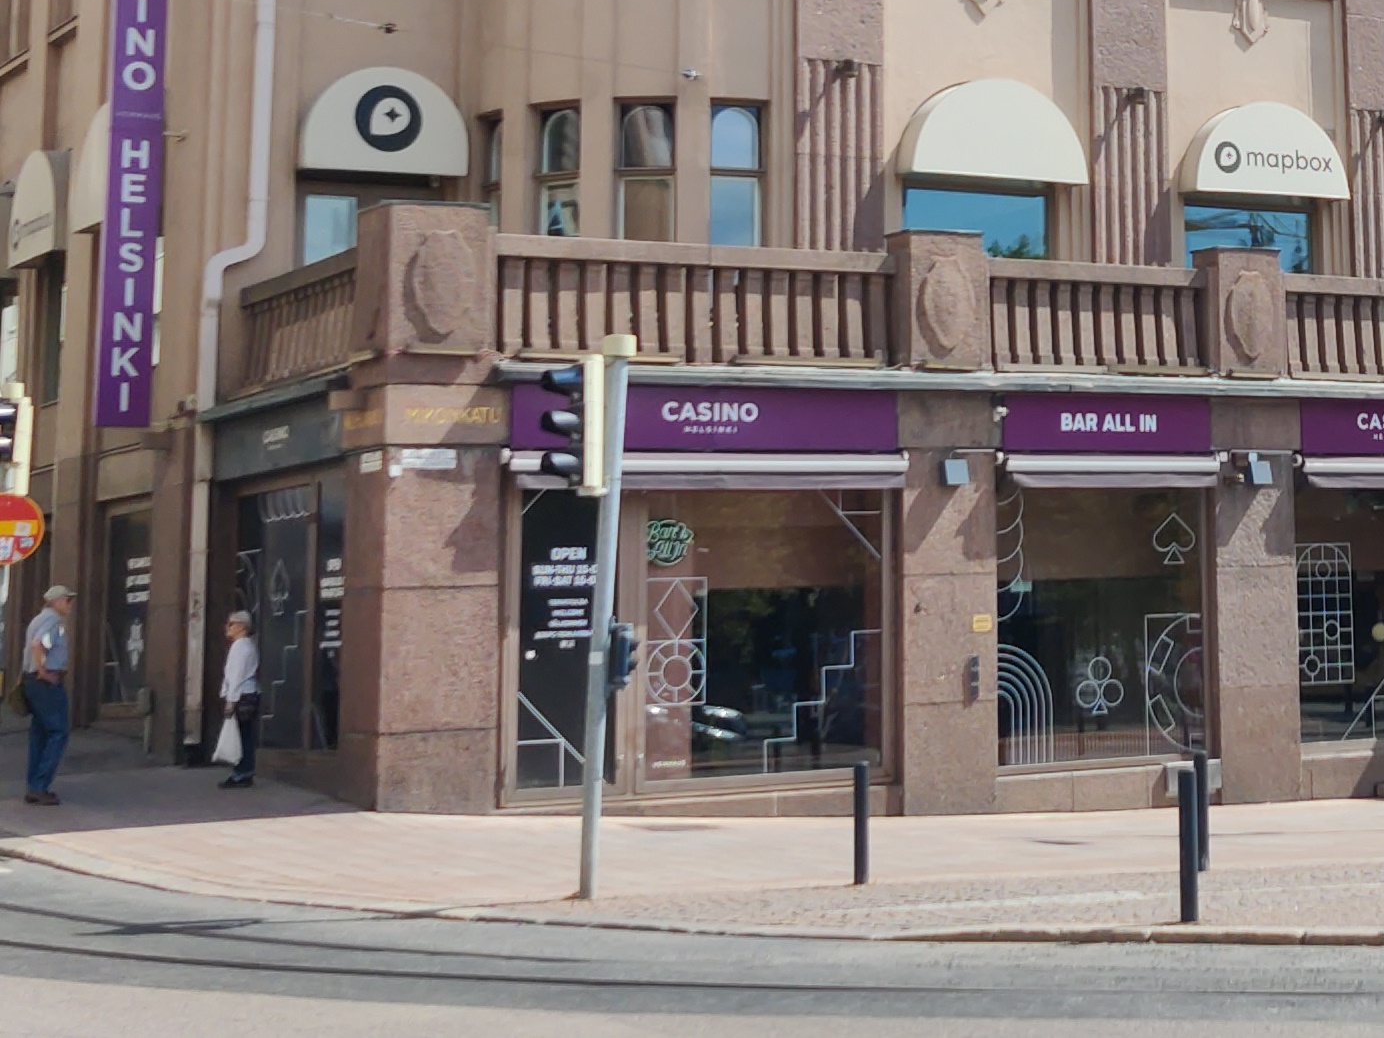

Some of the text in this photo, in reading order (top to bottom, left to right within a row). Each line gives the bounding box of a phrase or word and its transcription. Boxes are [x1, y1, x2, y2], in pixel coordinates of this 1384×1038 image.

[1246, 149, 1333, 174] mapbox
[111, 138, 150, 414] HELSINKI
[661, 400, 759, 422] CASINO
[1060, 412, 1157, 433] BAR ALL IN
[551, 547, 587, 560] OPEN
